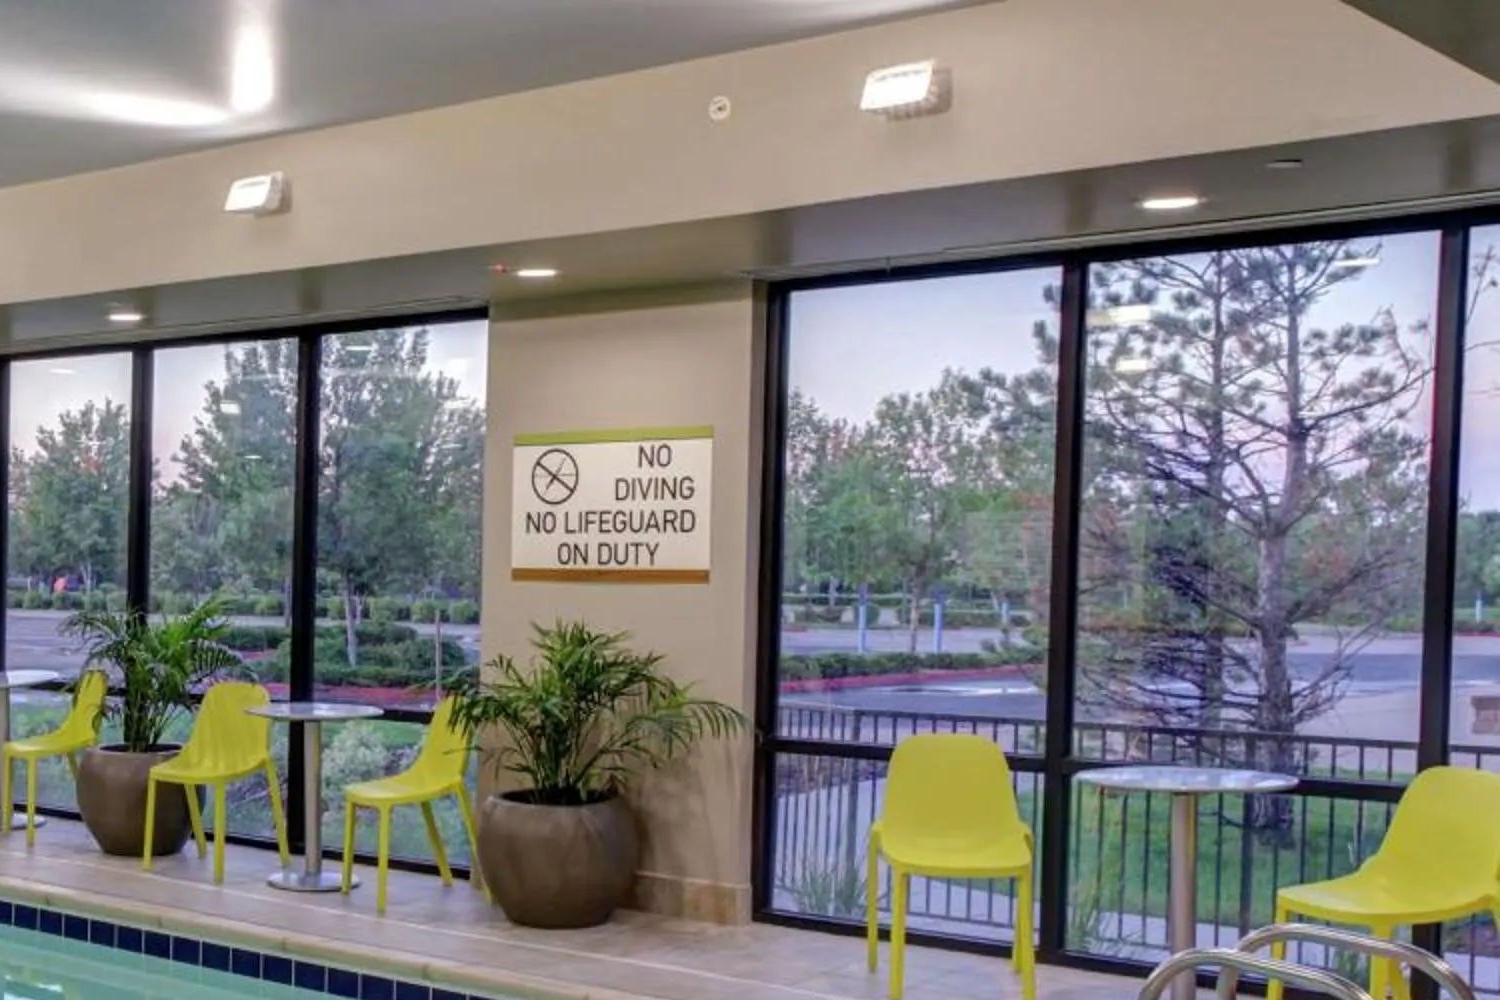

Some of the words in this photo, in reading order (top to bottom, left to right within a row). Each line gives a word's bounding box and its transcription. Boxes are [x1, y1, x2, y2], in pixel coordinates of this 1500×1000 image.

[638, 443, 672, 468] NO
[615, 476, 695, 501] DIVING
[525, 511, 557, 534] NO
[565, 509, 696, 534] LIFEGUARD
[557, 542, 588, 565] ON
[598, 543, 659, 566] DUTY
